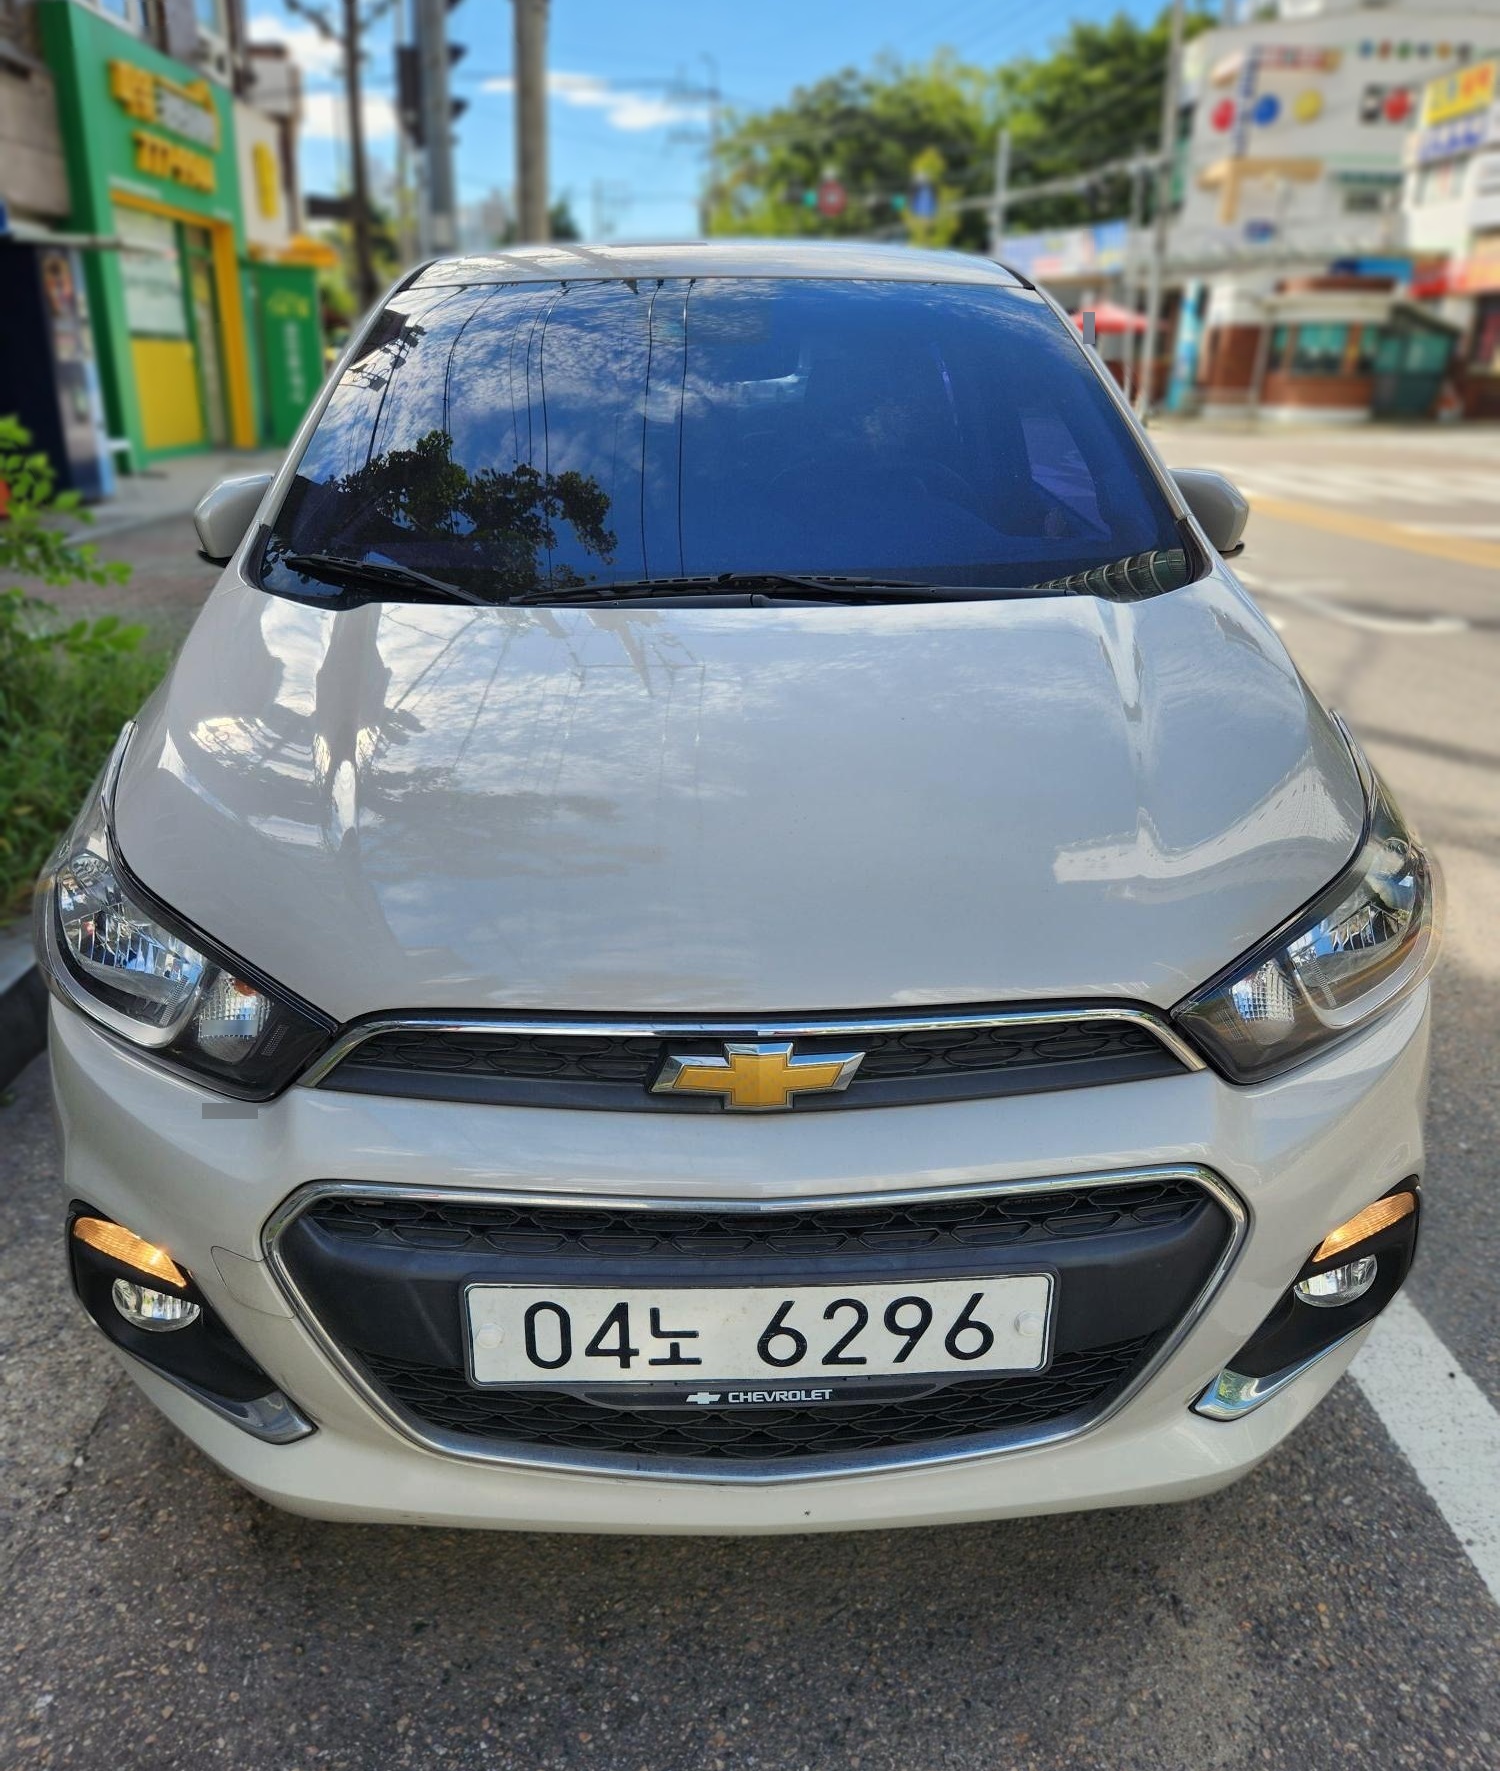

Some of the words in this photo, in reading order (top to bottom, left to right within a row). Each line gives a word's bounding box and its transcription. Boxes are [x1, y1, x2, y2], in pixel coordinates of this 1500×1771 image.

[523, 1300, 703, 1370] 04노
[756, 1292, 995, 1368] 6296
[728, 1389, 833, 1403] CHEVROLET
